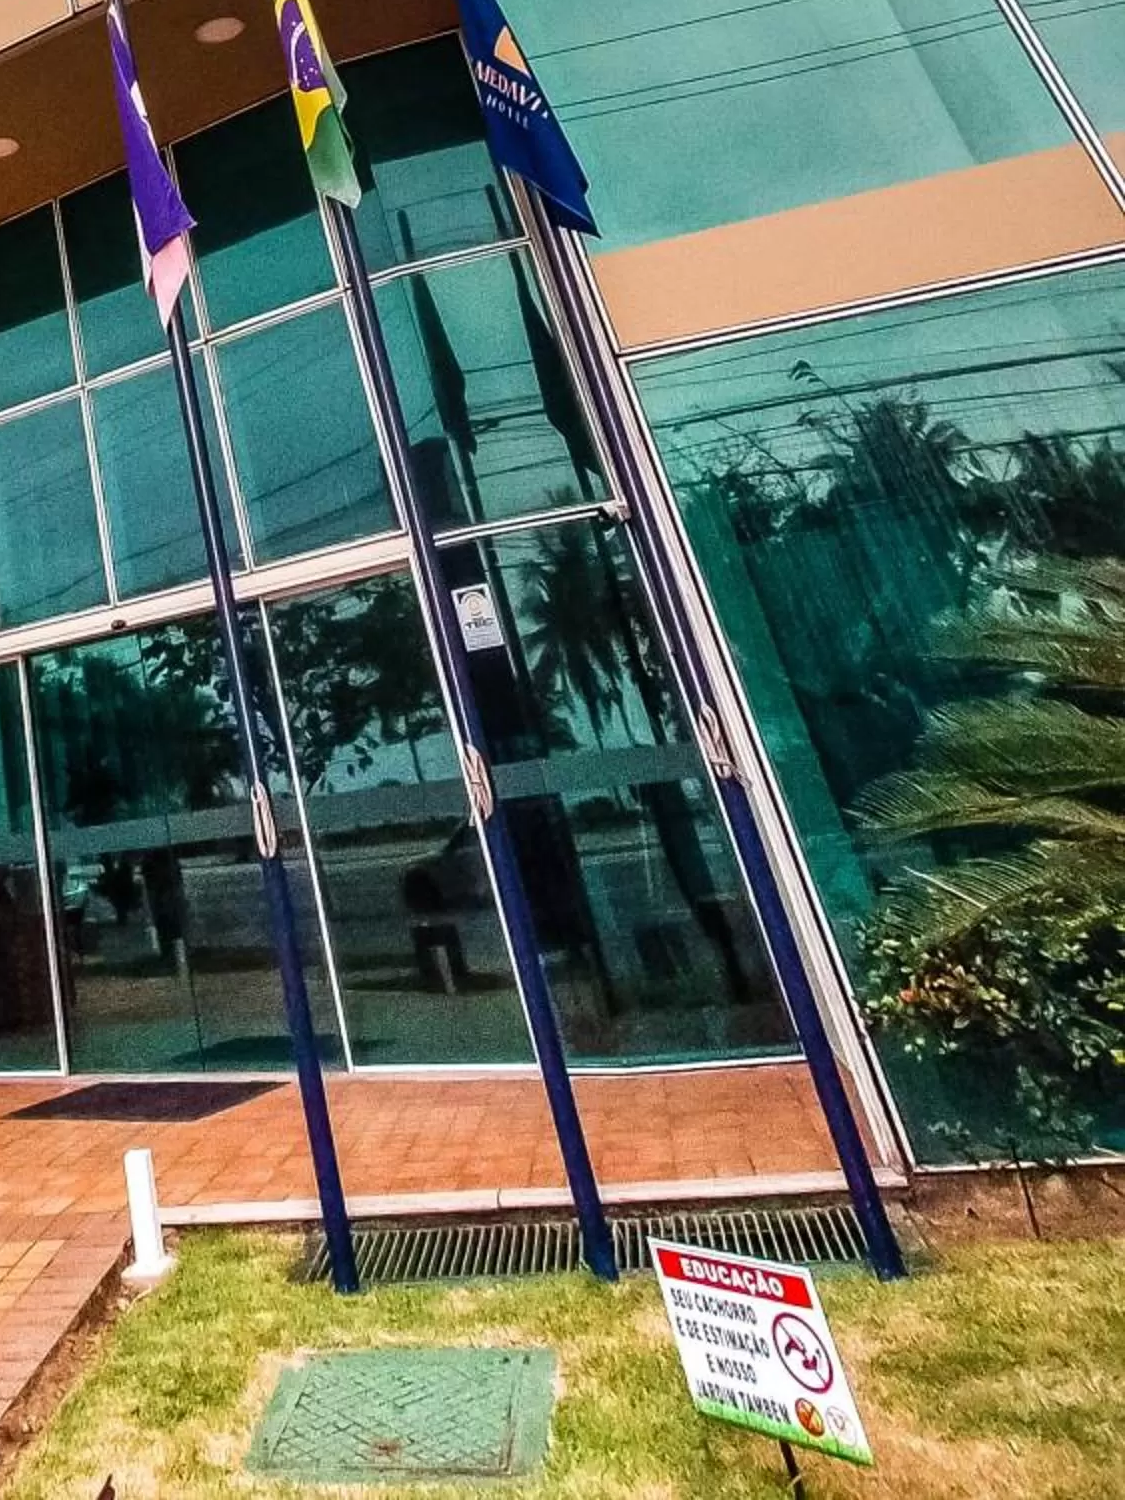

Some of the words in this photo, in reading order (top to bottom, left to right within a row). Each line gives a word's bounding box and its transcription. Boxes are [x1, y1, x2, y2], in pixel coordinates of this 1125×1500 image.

[679, 1256, 785, 1298] EDUCAÇÃO
[670, 1287, 693, 1311] SEU
[694, 1292, 757, 1325] CACHORRO
[685, 1319, 703, 1341] DE
[716, 1356, 757, 1385] NOSSO
